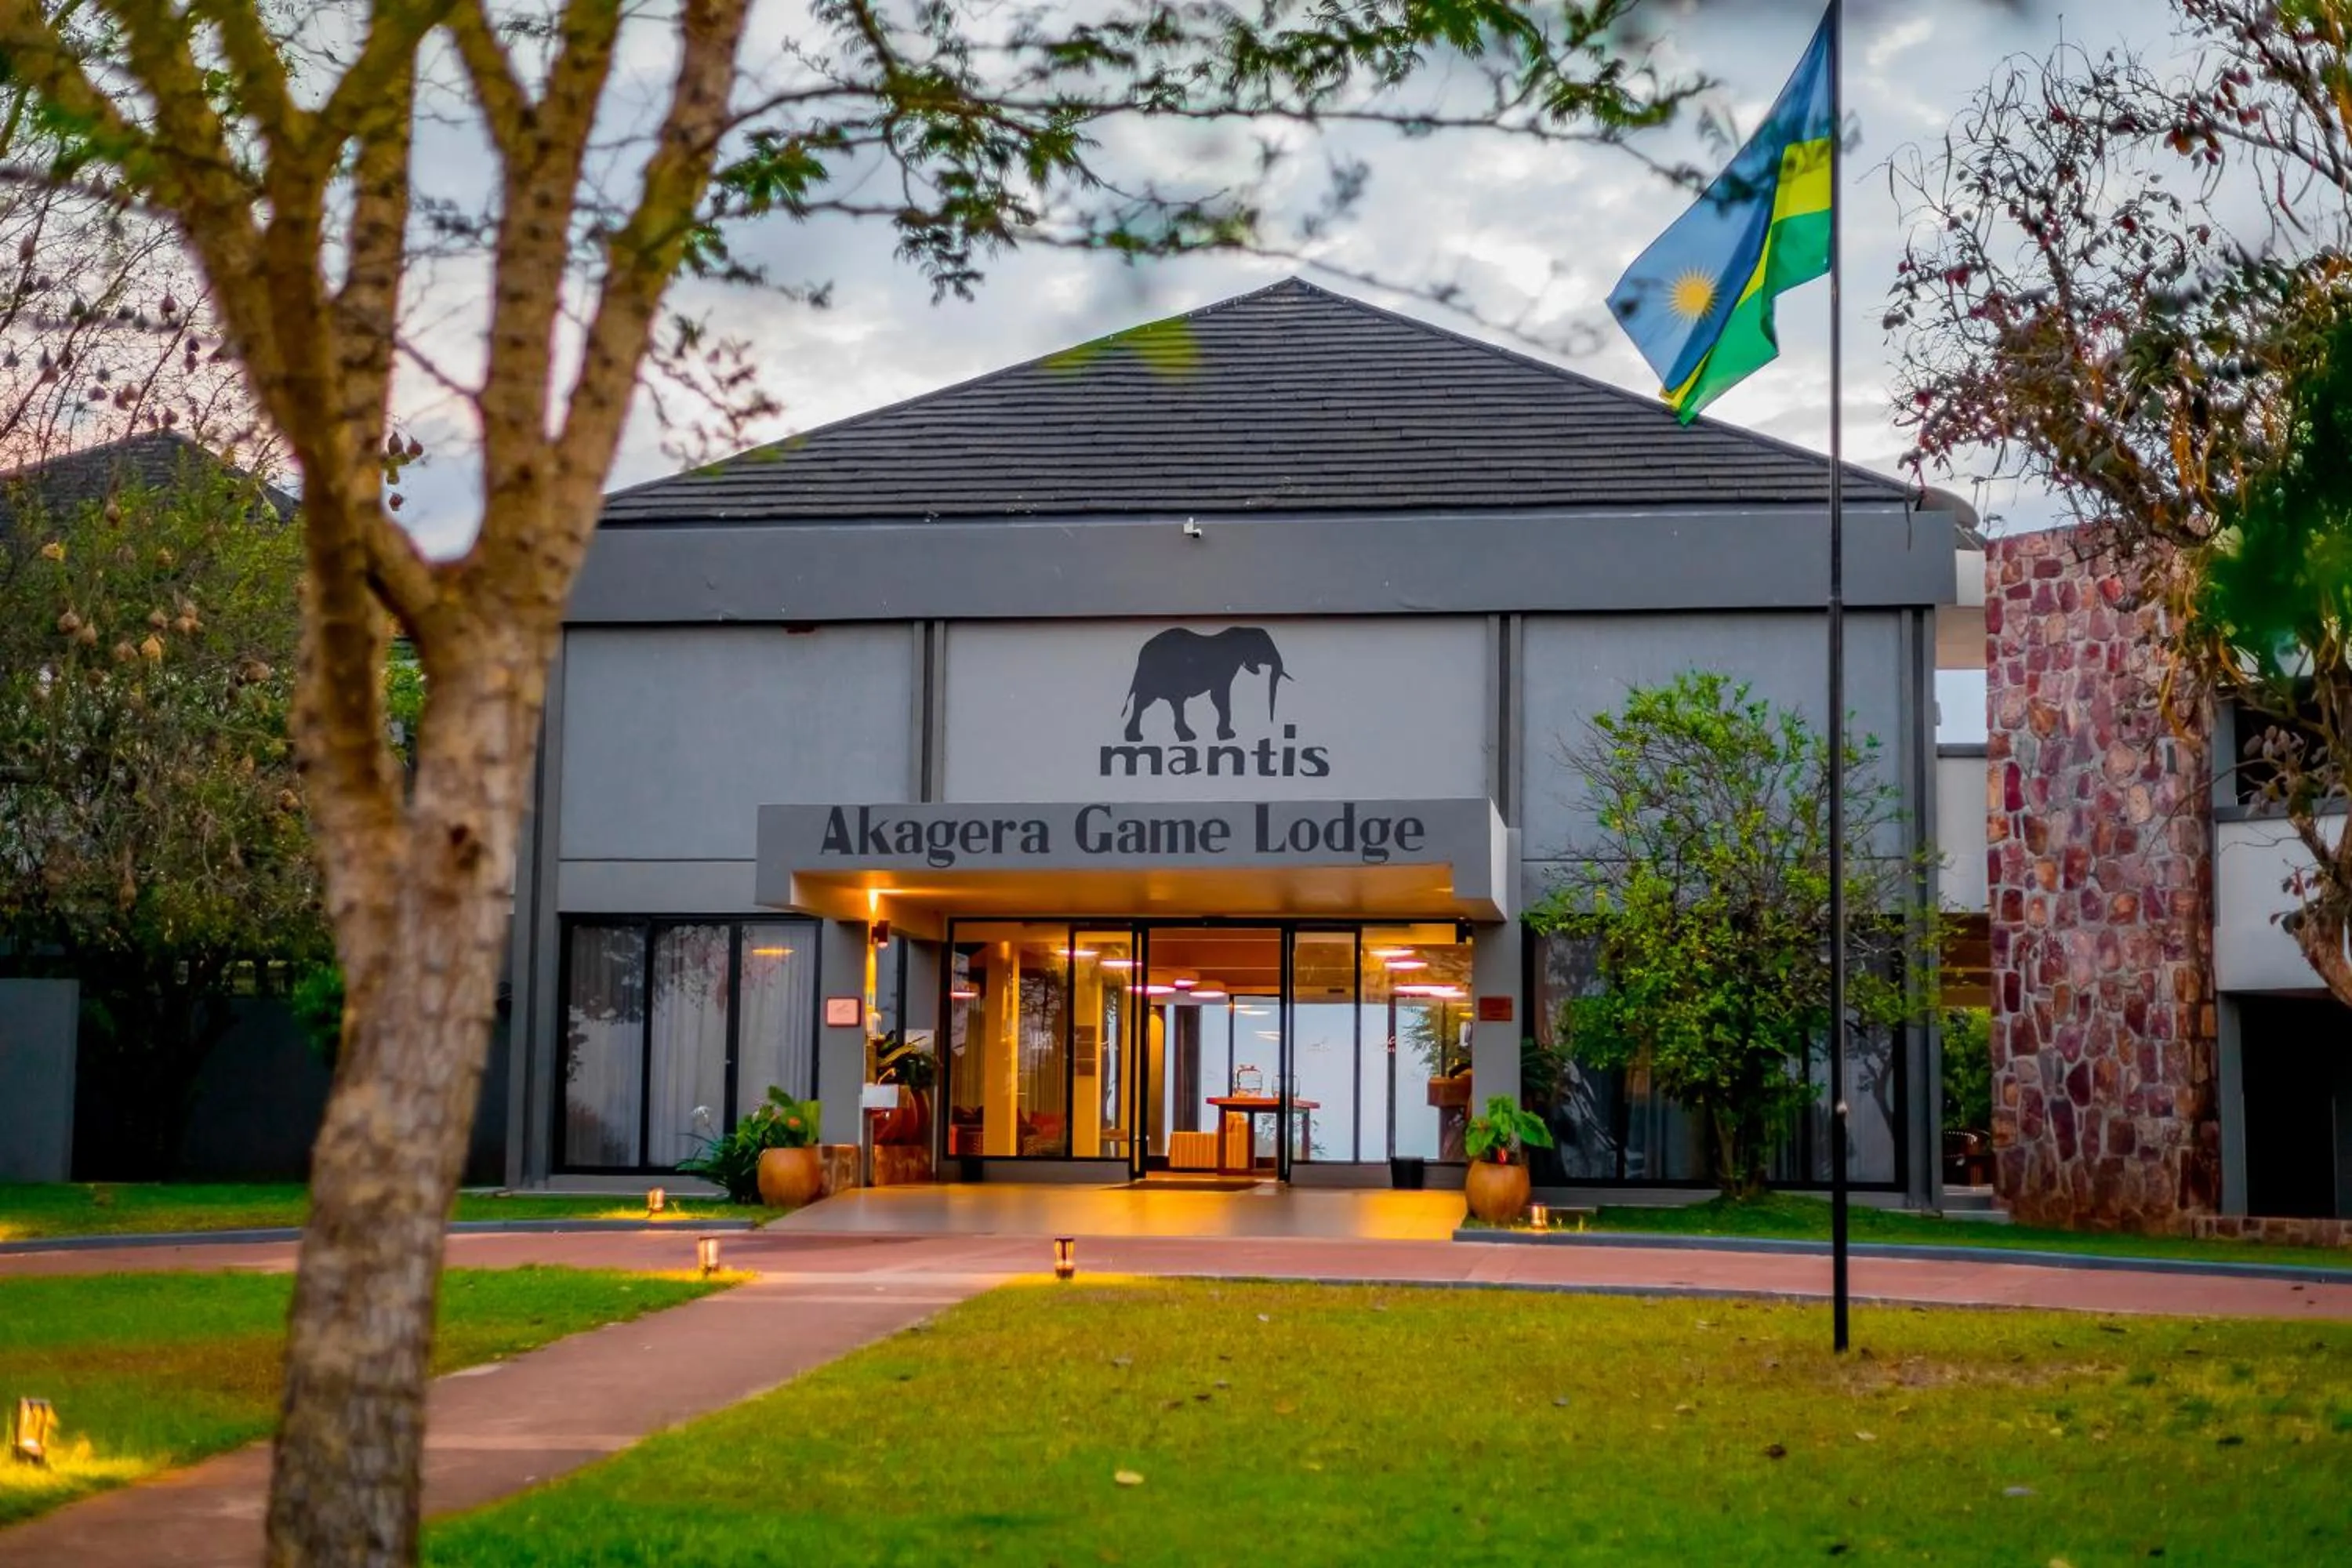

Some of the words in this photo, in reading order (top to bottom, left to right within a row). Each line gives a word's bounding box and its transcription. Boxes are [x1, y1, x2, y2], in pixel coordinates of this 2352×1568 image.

[1100, 724, 1330, 777] mantis
[820, 805, 1051, 868] Akagera
[1075, 804, 1231, 855] Game
[1255, 802, 1425, 866] Lodge
